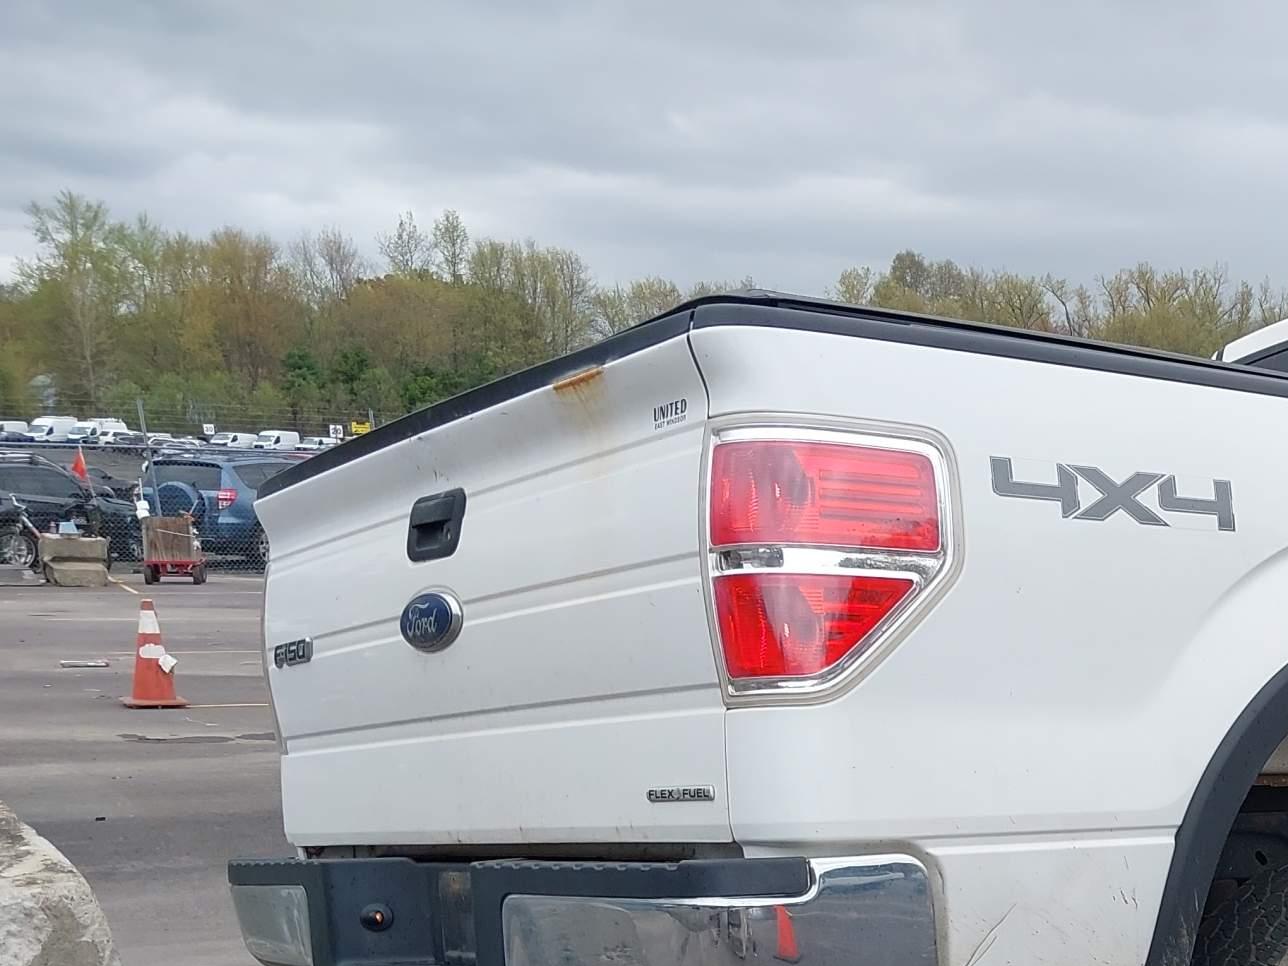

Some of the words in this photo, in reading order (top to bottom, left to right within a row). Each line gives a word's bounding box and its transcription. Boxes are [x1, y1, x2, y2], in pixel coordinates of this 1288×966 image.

[653, 398, 687, 422] UNITED
[406, 602, 438, 638] Ford
[648, 789, 674, 799] FLEX
[682, 788, 709, 798] FUEL
